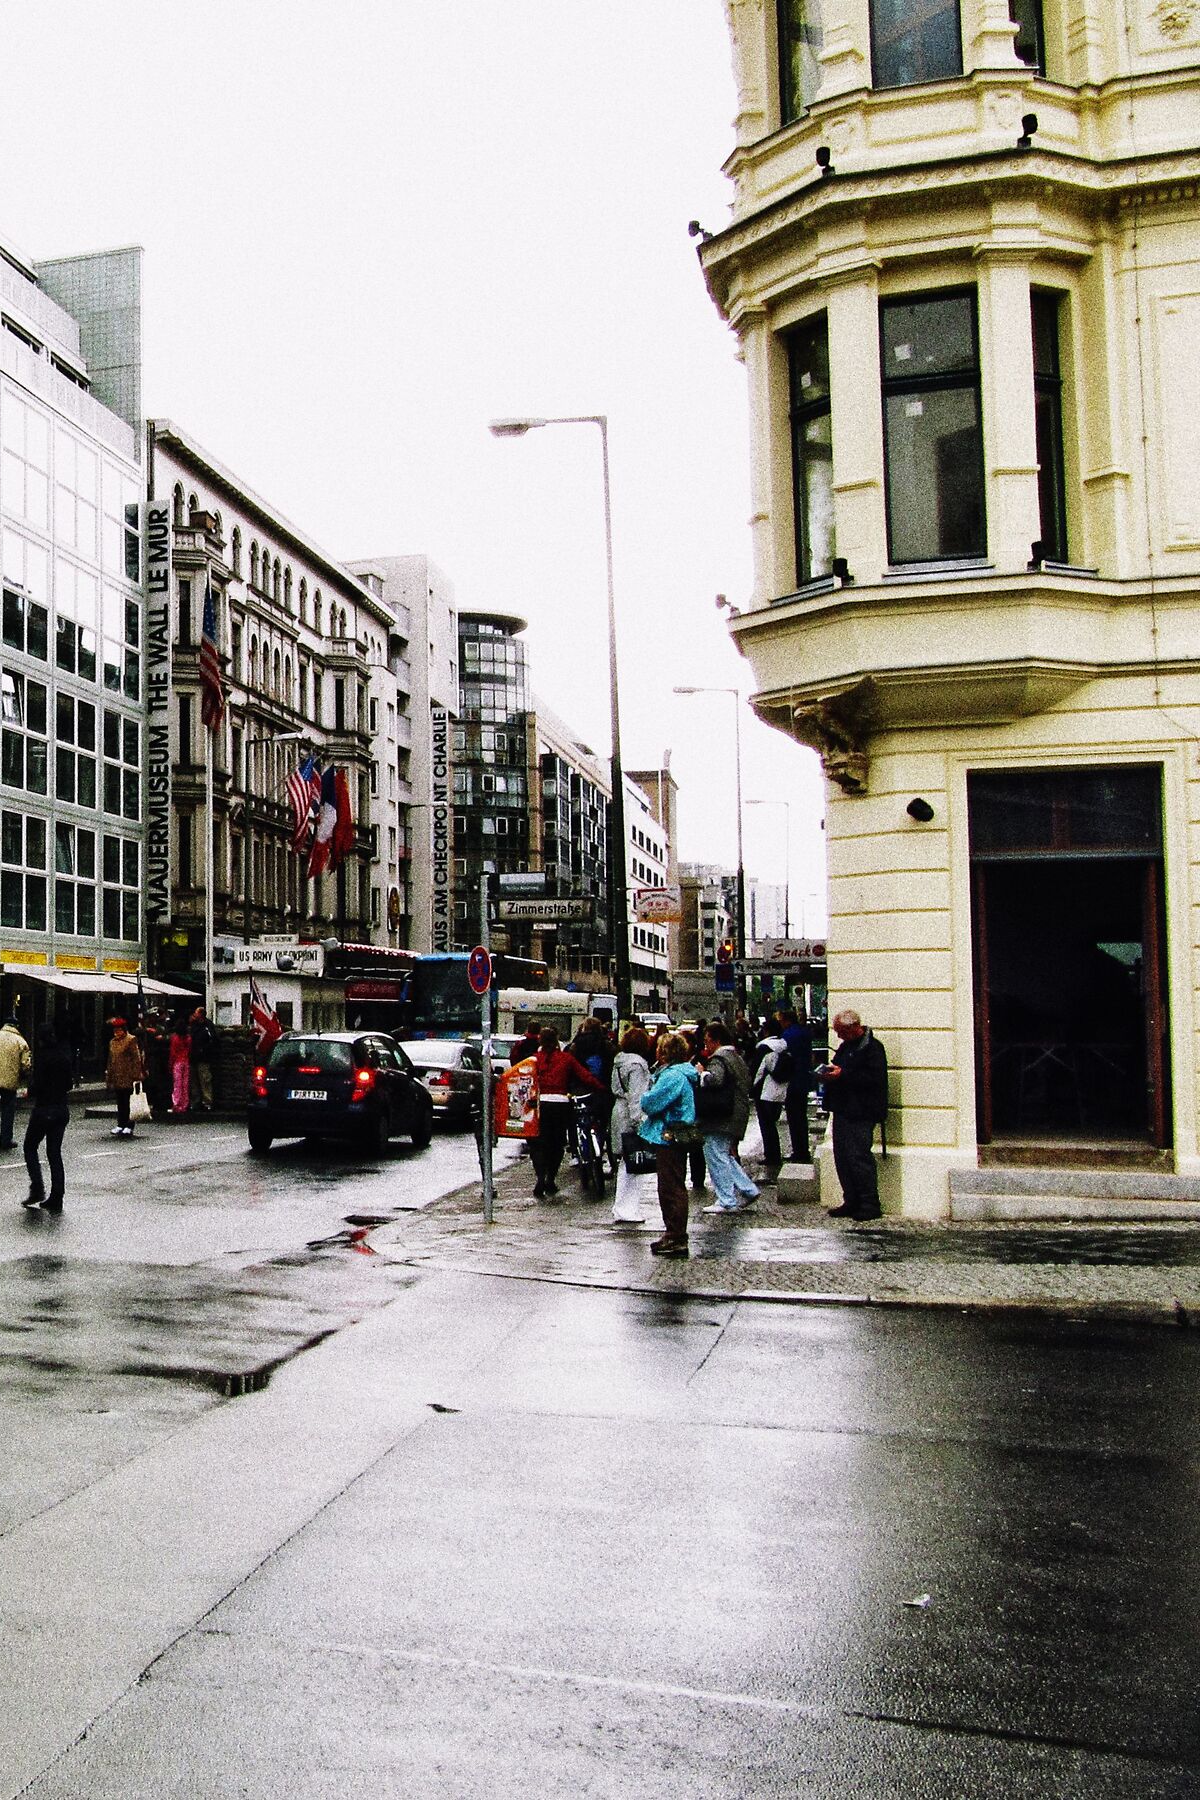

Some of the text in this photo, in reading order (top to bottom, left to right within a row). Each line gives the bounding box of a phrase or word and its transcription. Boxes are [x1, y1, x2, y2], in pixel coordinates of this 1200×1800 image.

[147, 507, 169, 919] MAUERMUSEUM THE WALL LE MUR
[431, 712, 448, 951] AUS AM CHECKPOINT CHARLIE
[507, 902, 580, 917] Zimmerstraße
[239, 951, 249, 962] US
[252, 951, 272, 962] ARMY
[771, 943, 811, 960] Snack
